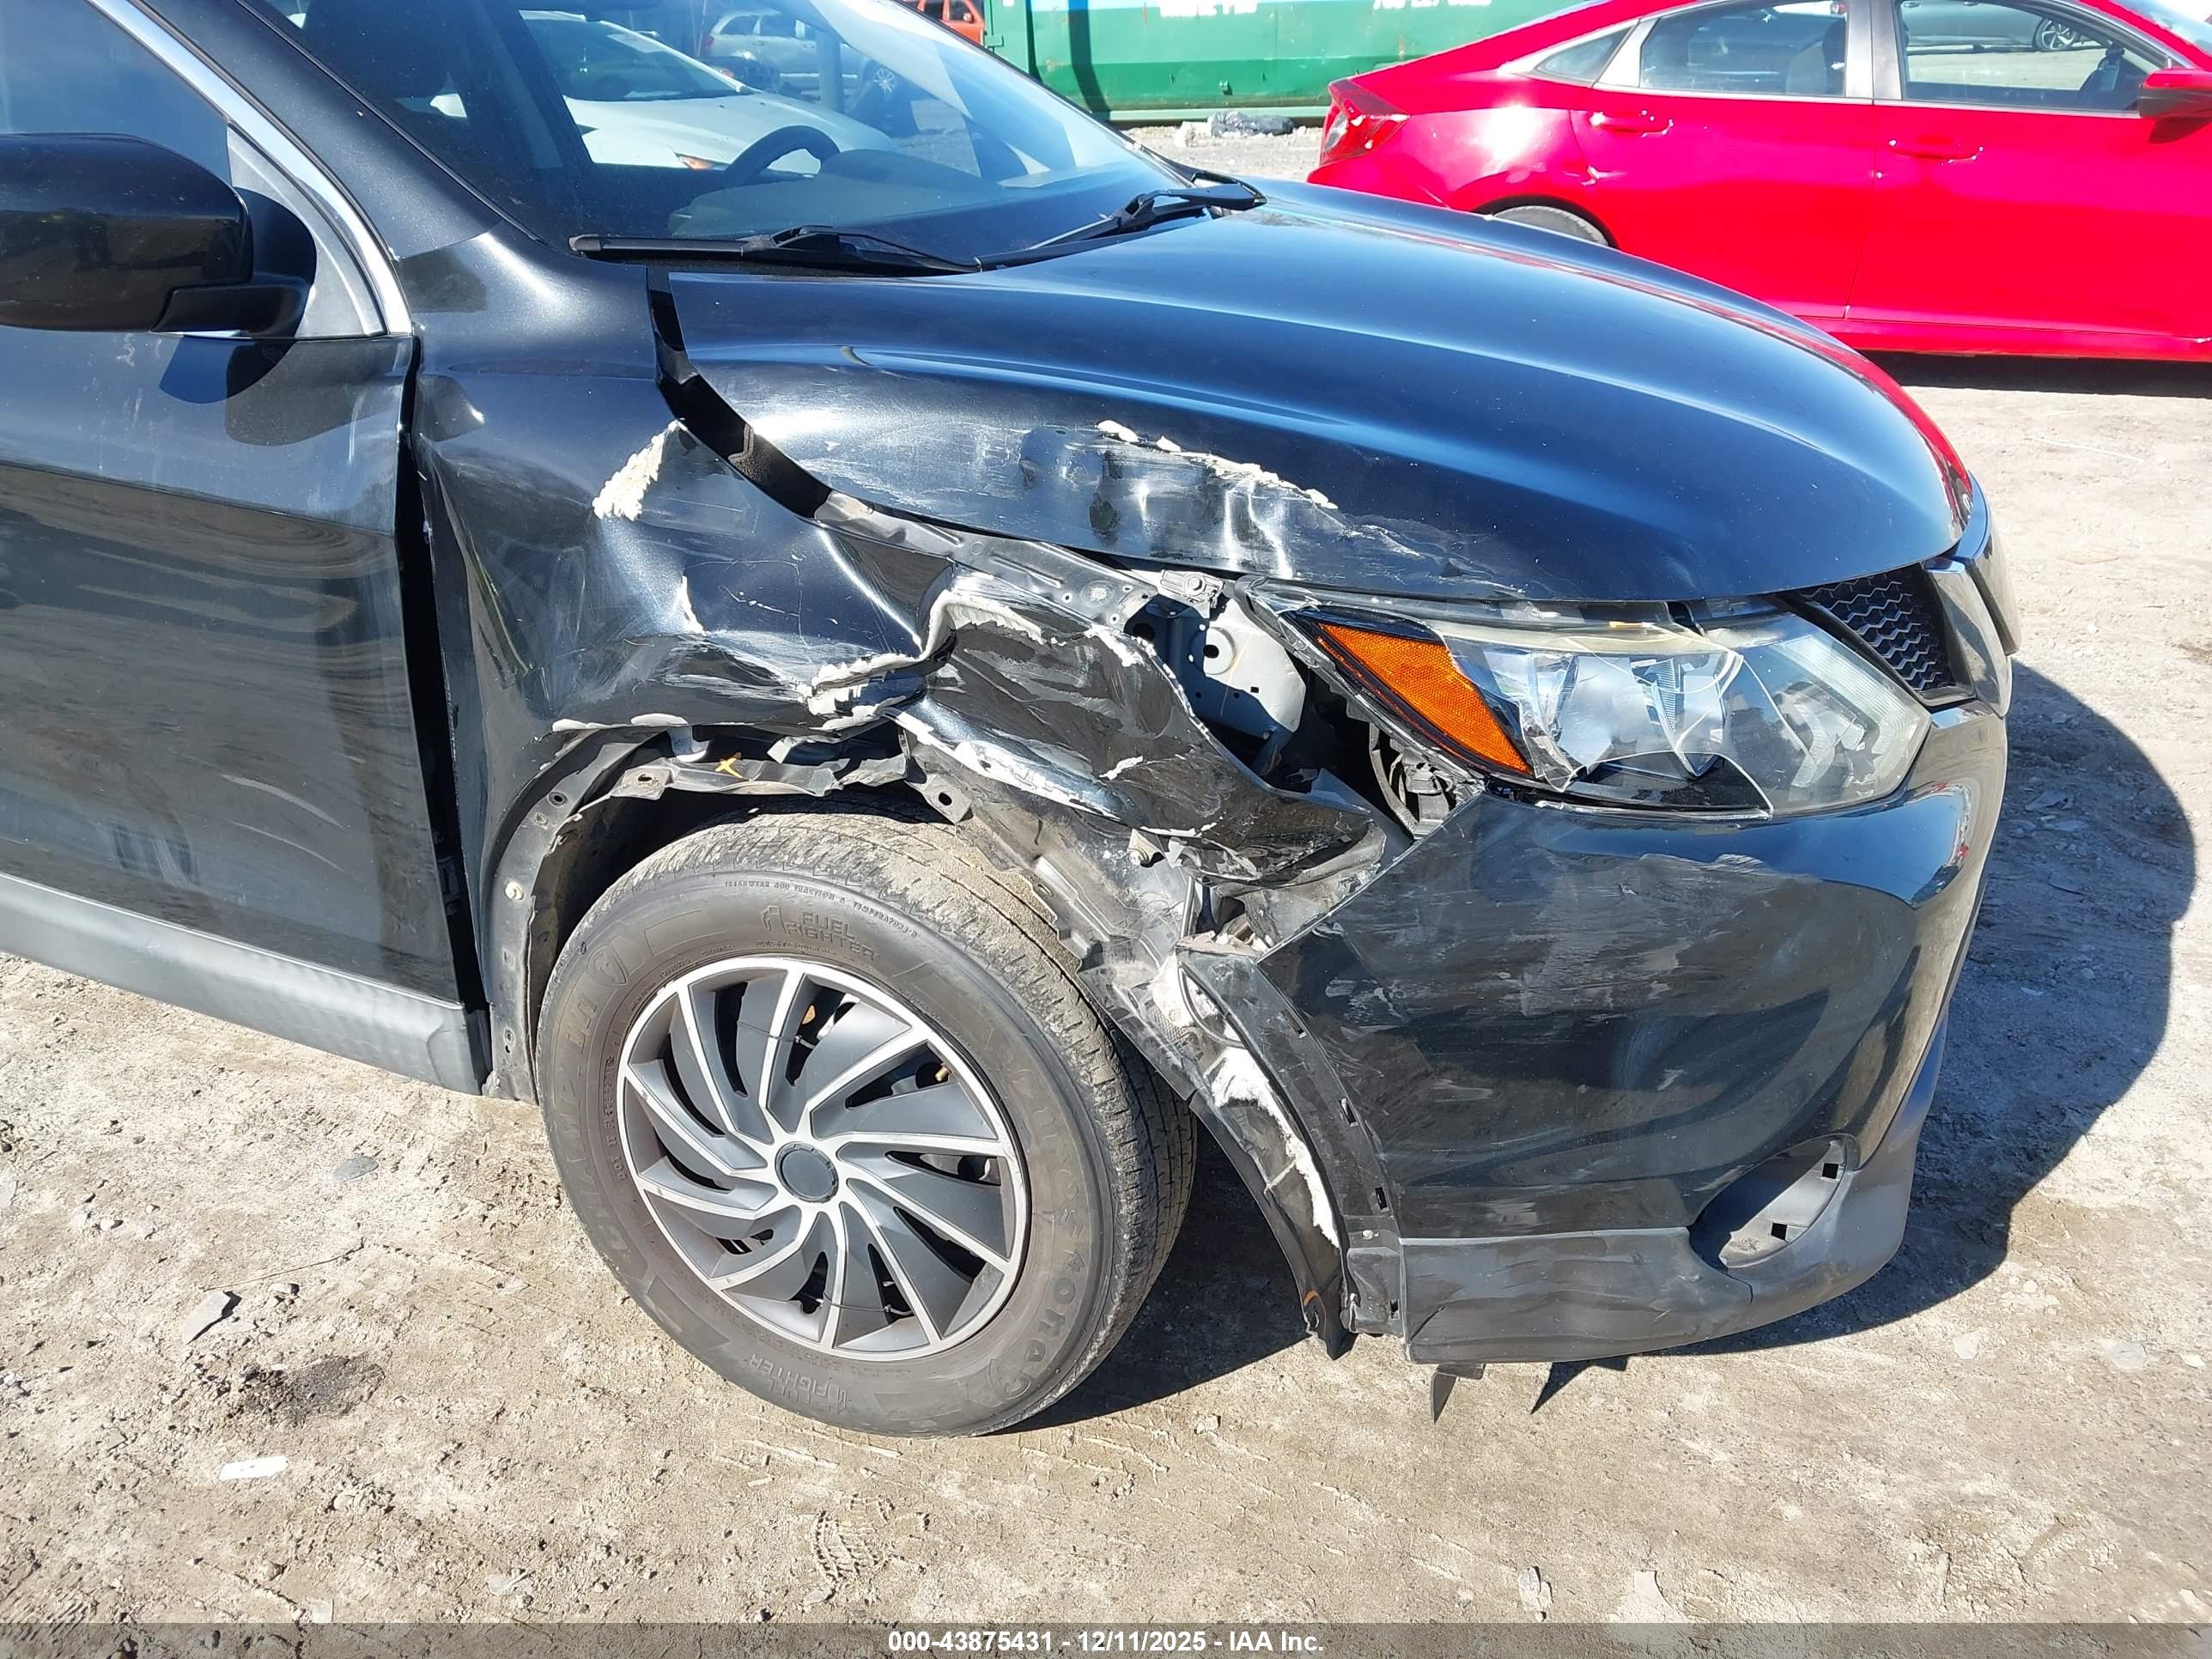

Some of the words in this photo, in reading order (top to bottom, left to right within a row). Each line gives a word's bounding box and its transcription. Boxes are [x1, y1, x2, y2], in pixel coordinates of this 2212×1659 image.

[783, 921, 876, 962] FIGHTER
[802, 910, 856, 941] FUEL
[747, 1352, 830, 1397] FIGHTER
